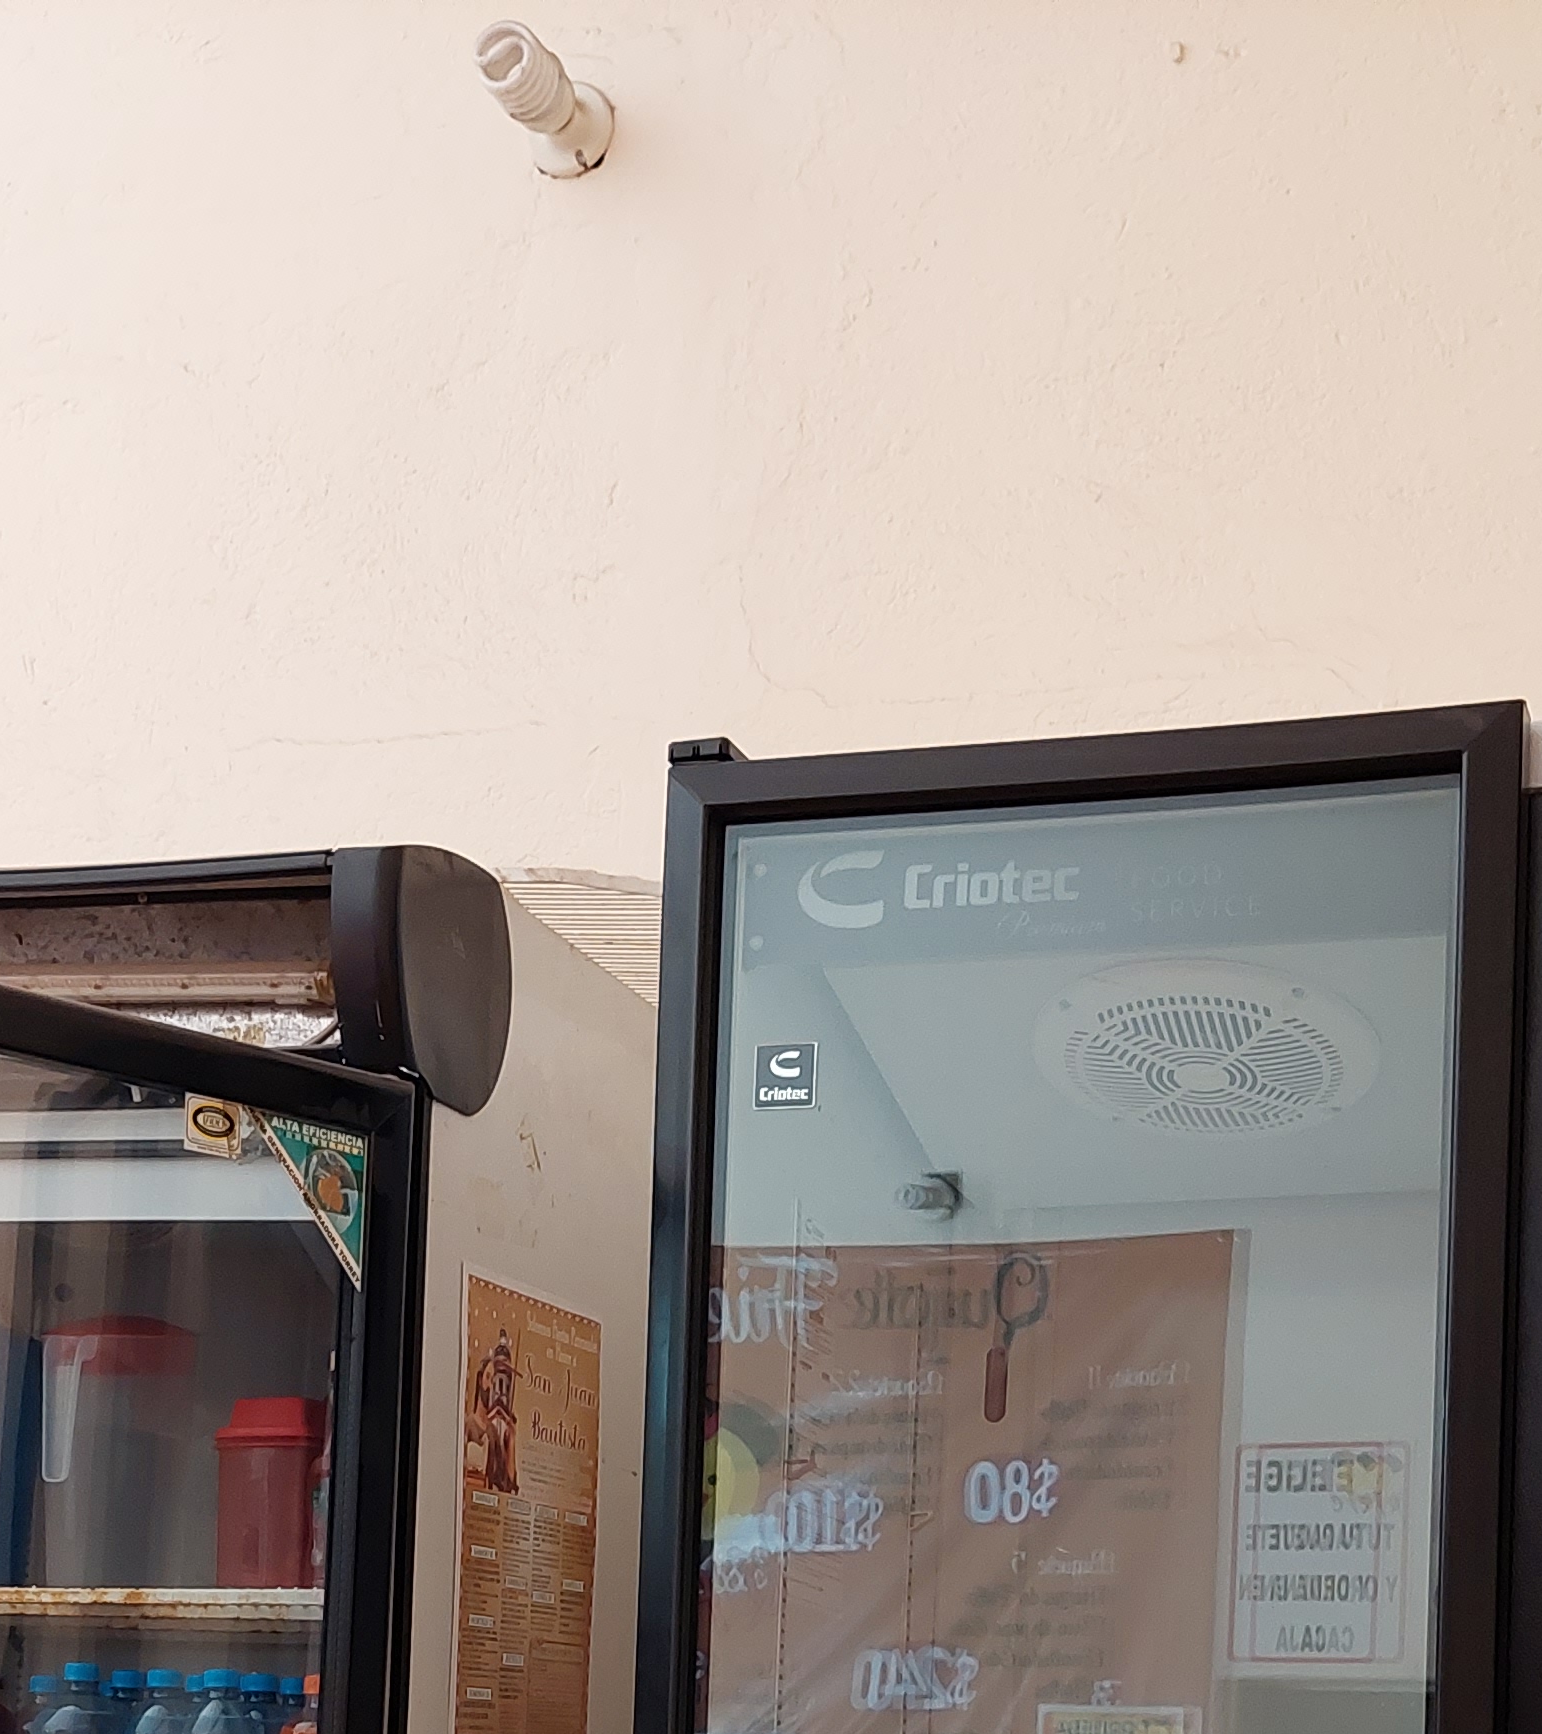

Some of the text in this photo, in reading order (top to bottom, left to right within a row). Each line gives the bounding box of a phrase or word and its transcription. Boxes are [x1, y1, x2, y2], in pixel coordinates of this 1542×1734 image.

[902, 859, 1081, 911] Criotec
[759, 1086, 809, 1102] Criotec
[271, 1116, 300, 1134] ALTA
[302, 1123, 365, 1149] EFICIENCIA
[525, 1354, 553, 1395] San
[560, 1368, 597, 1415] Juan
[531, 1410, 587, 1451] Bautista
